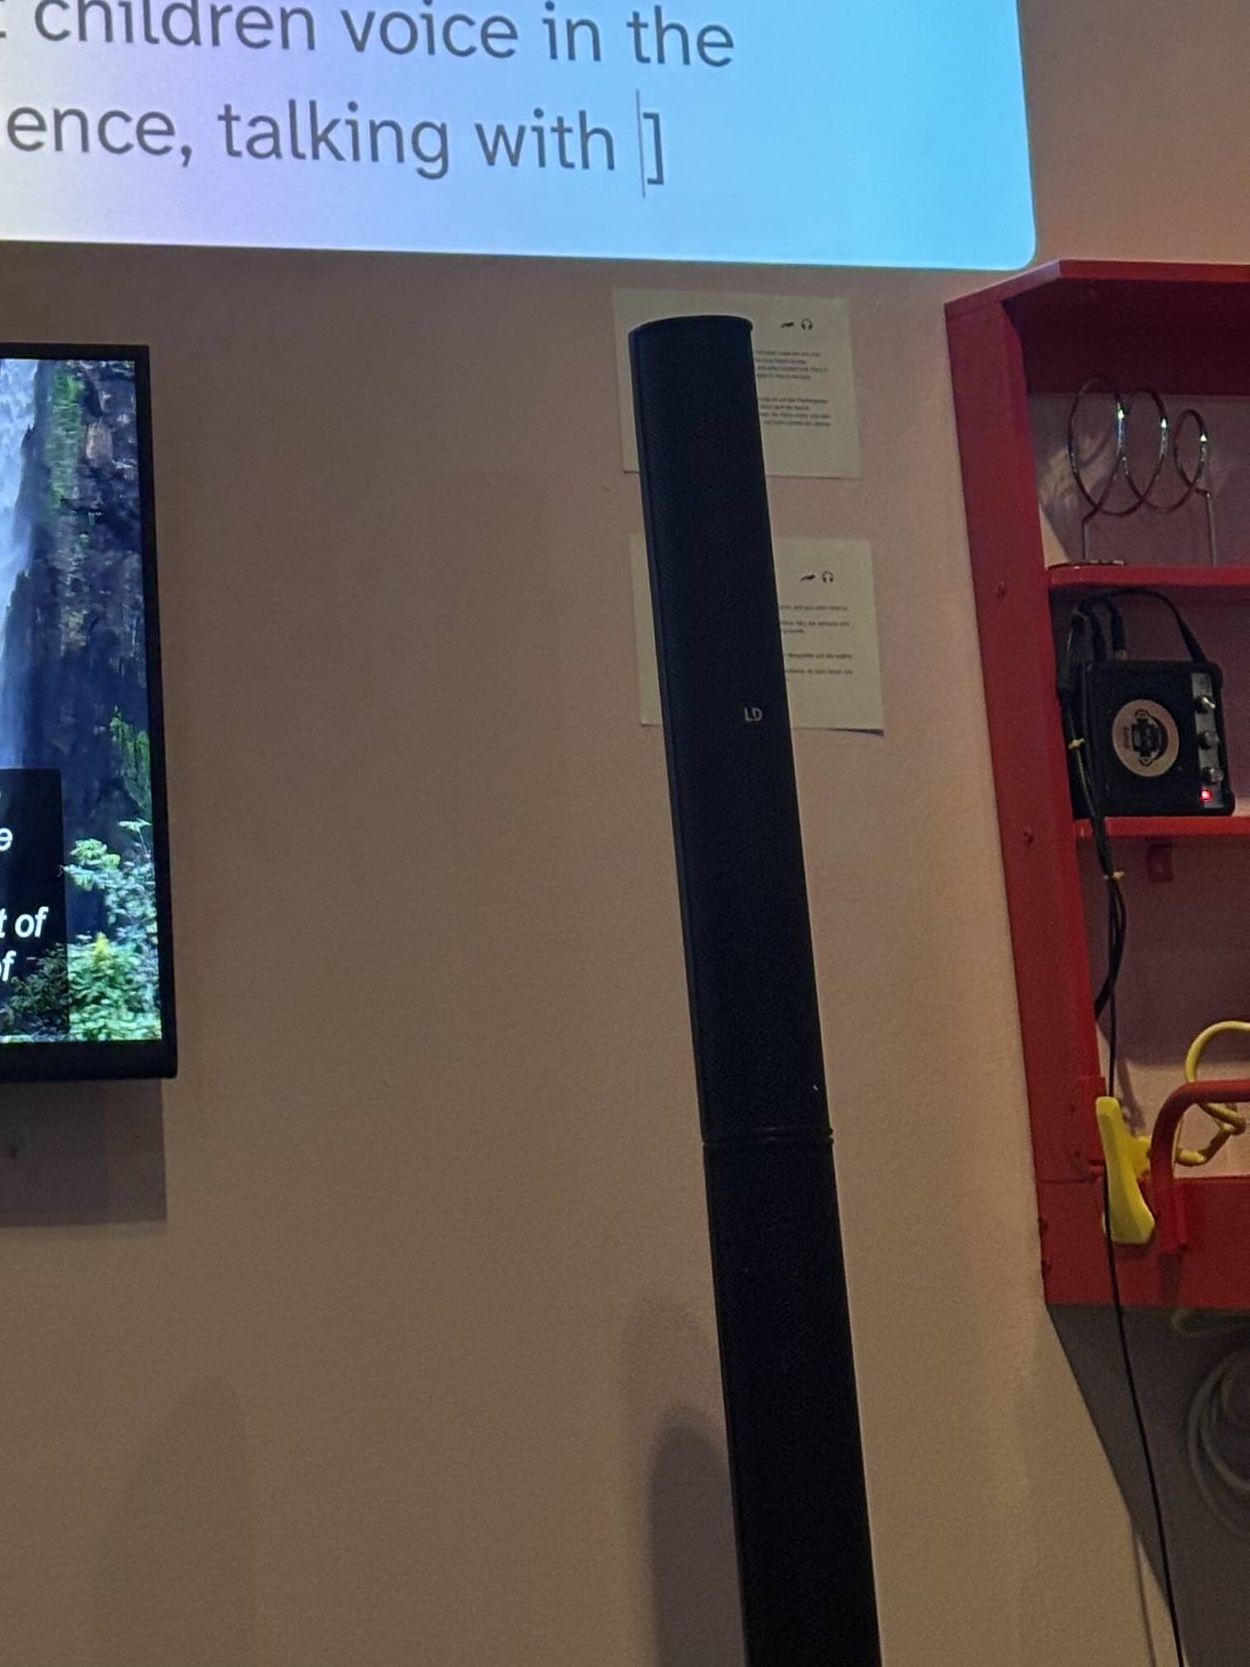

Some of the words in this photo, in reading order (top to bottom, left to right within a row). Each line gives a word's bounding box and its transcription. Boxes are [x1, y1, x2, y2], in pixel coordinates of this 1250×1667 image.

[541, 0, 602, 63] in
[625, 4, 735, 68] the
[217, 98, 450, 181] talking
[474, 107, 616, 171] with
[744, 706, 763, 722] LD
[14, 906, 49, 938] of
